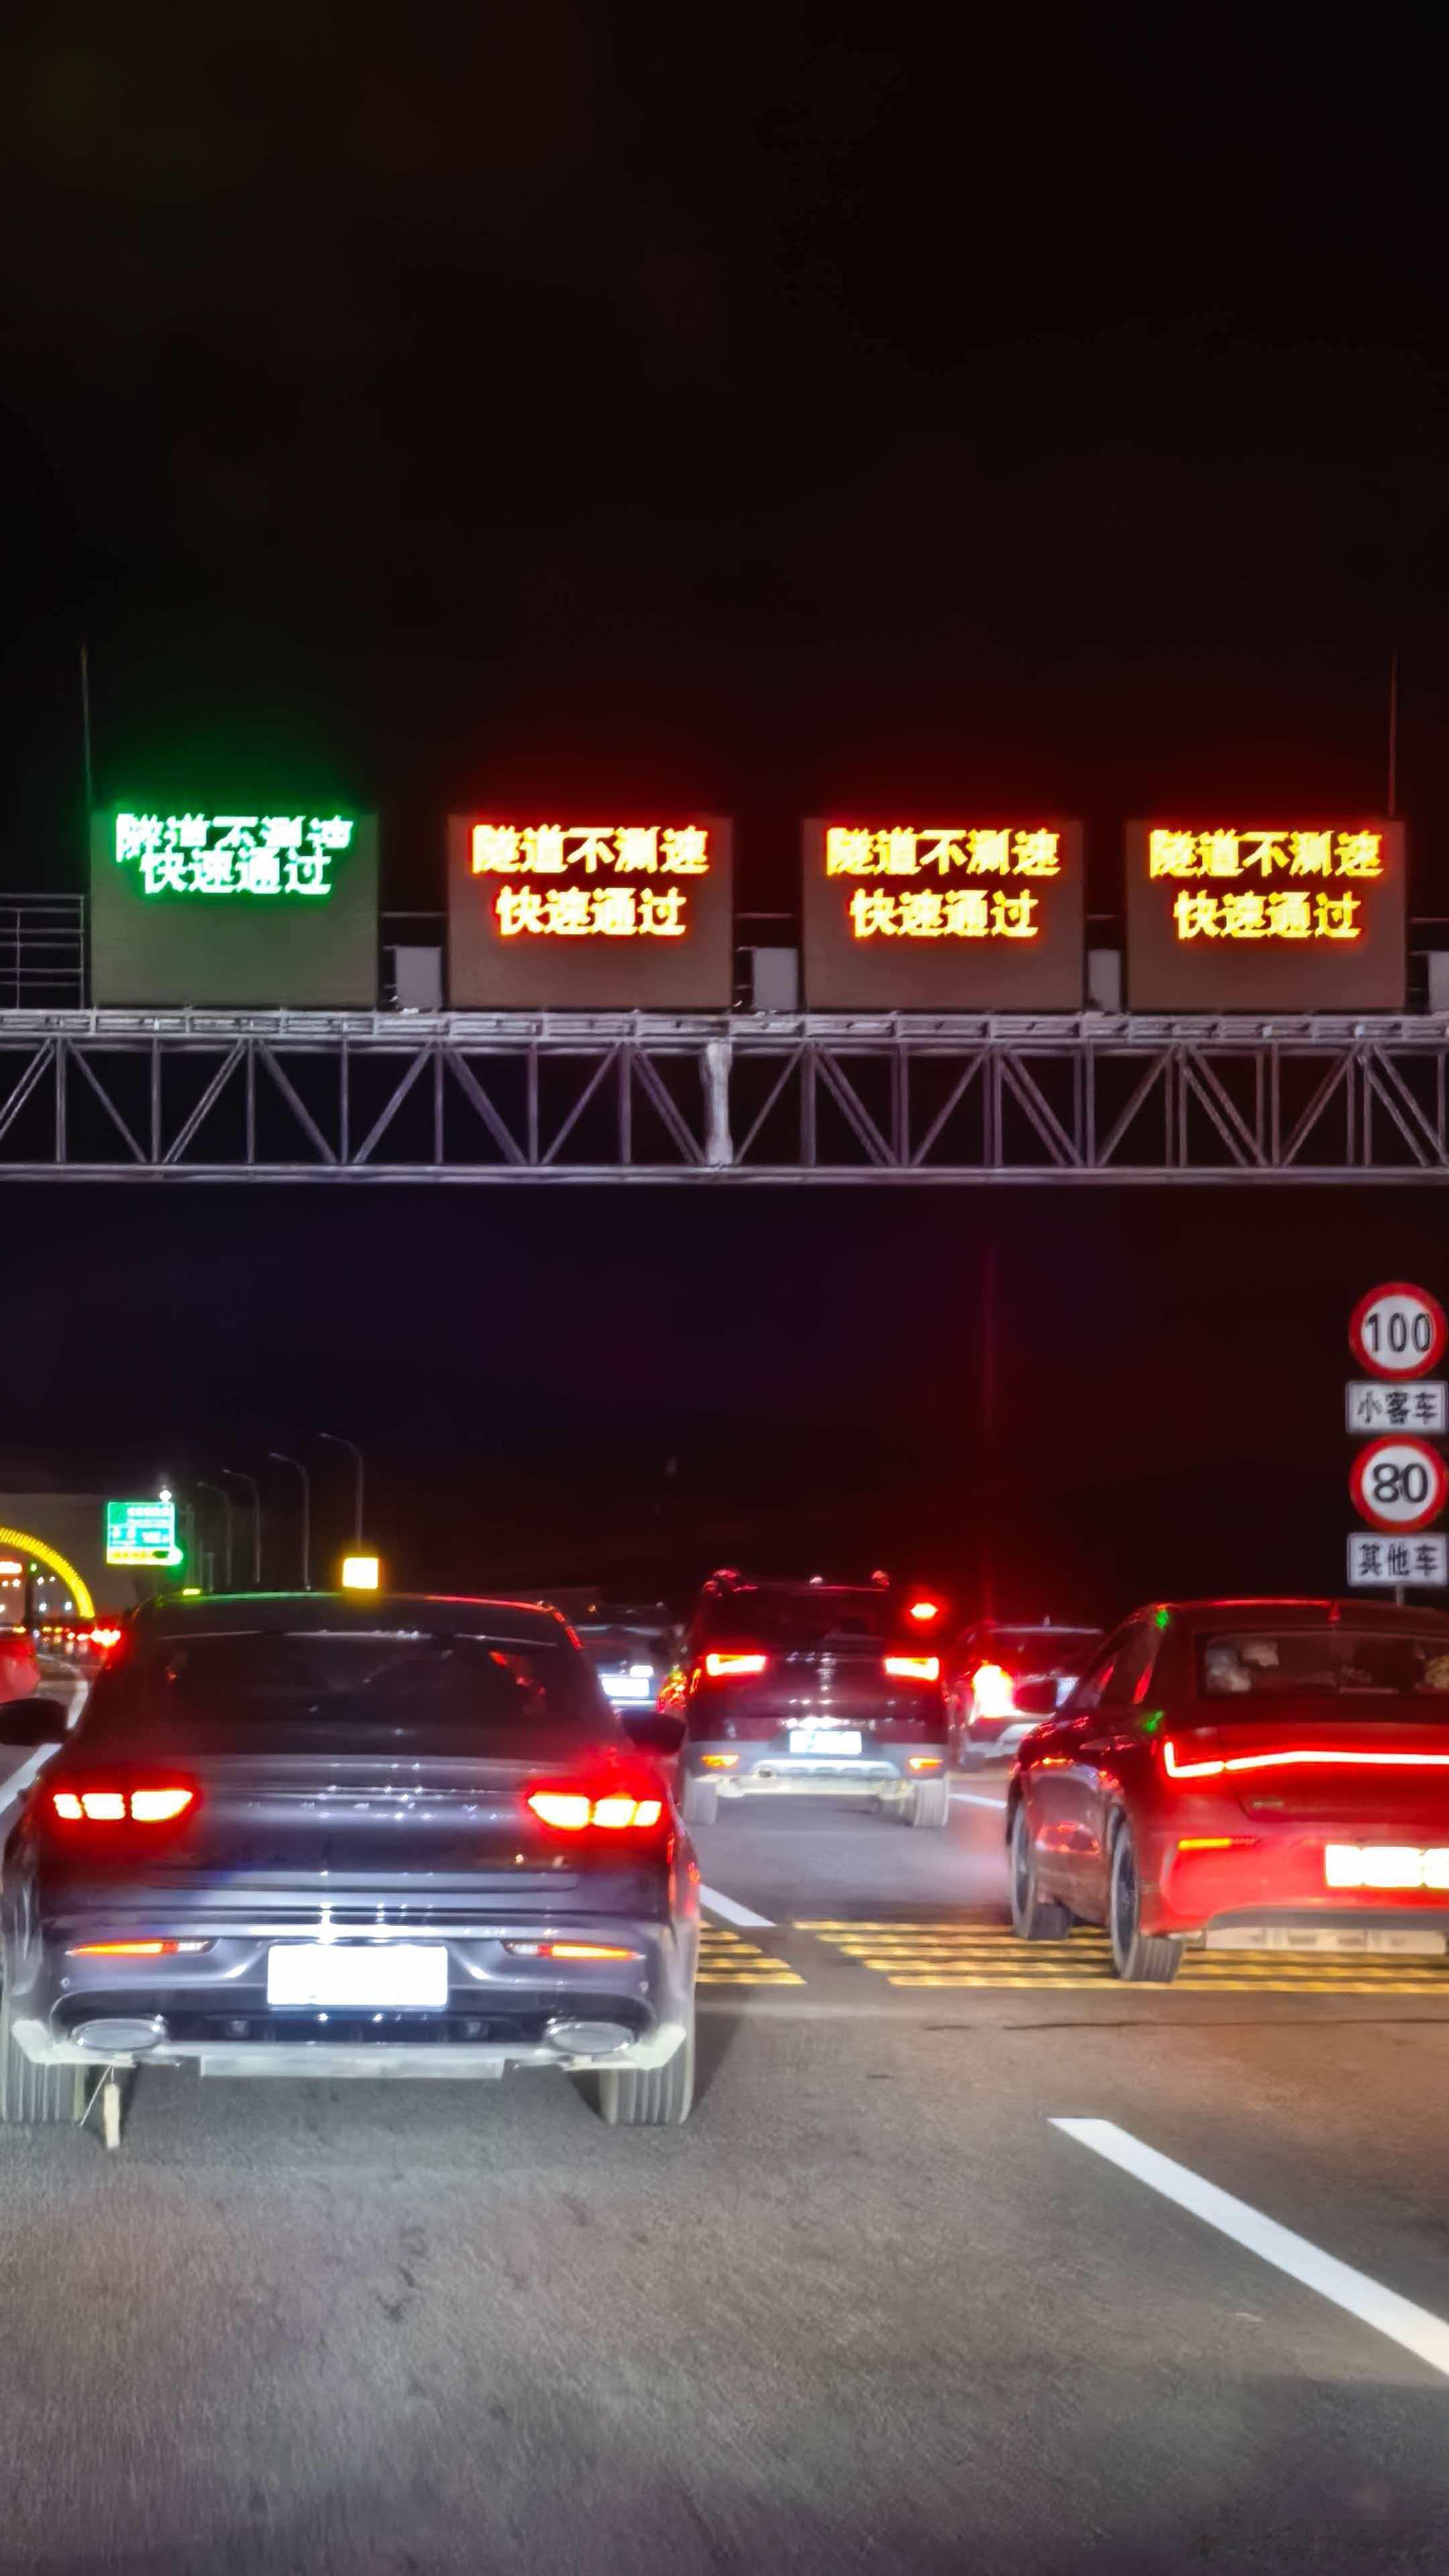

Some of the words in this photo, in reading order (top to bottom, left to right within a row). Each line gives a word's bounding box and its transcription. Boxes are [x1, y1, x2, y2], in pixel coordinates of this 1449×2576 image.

[140, 847, 331, 895] 快速通过
[472, 824, 708, 874] 隧道不测速
[826, 826, 1060, 876] 隧道不测速
[1150, 828, 1383, 878] 隧道不测速
[496, 885, 686, 936] 快速通过
[850, 888, 1038, 938] 快速通过
[1173, 890, 1361, 939] 快速通过
[1366, 1312, 1432, 1353] 100
[1358, 1391, 1436, 1424] 小客车
[1373, 1463, 1428, 1503] 80
[1359, 1544, 1437, 1576] 其他车
